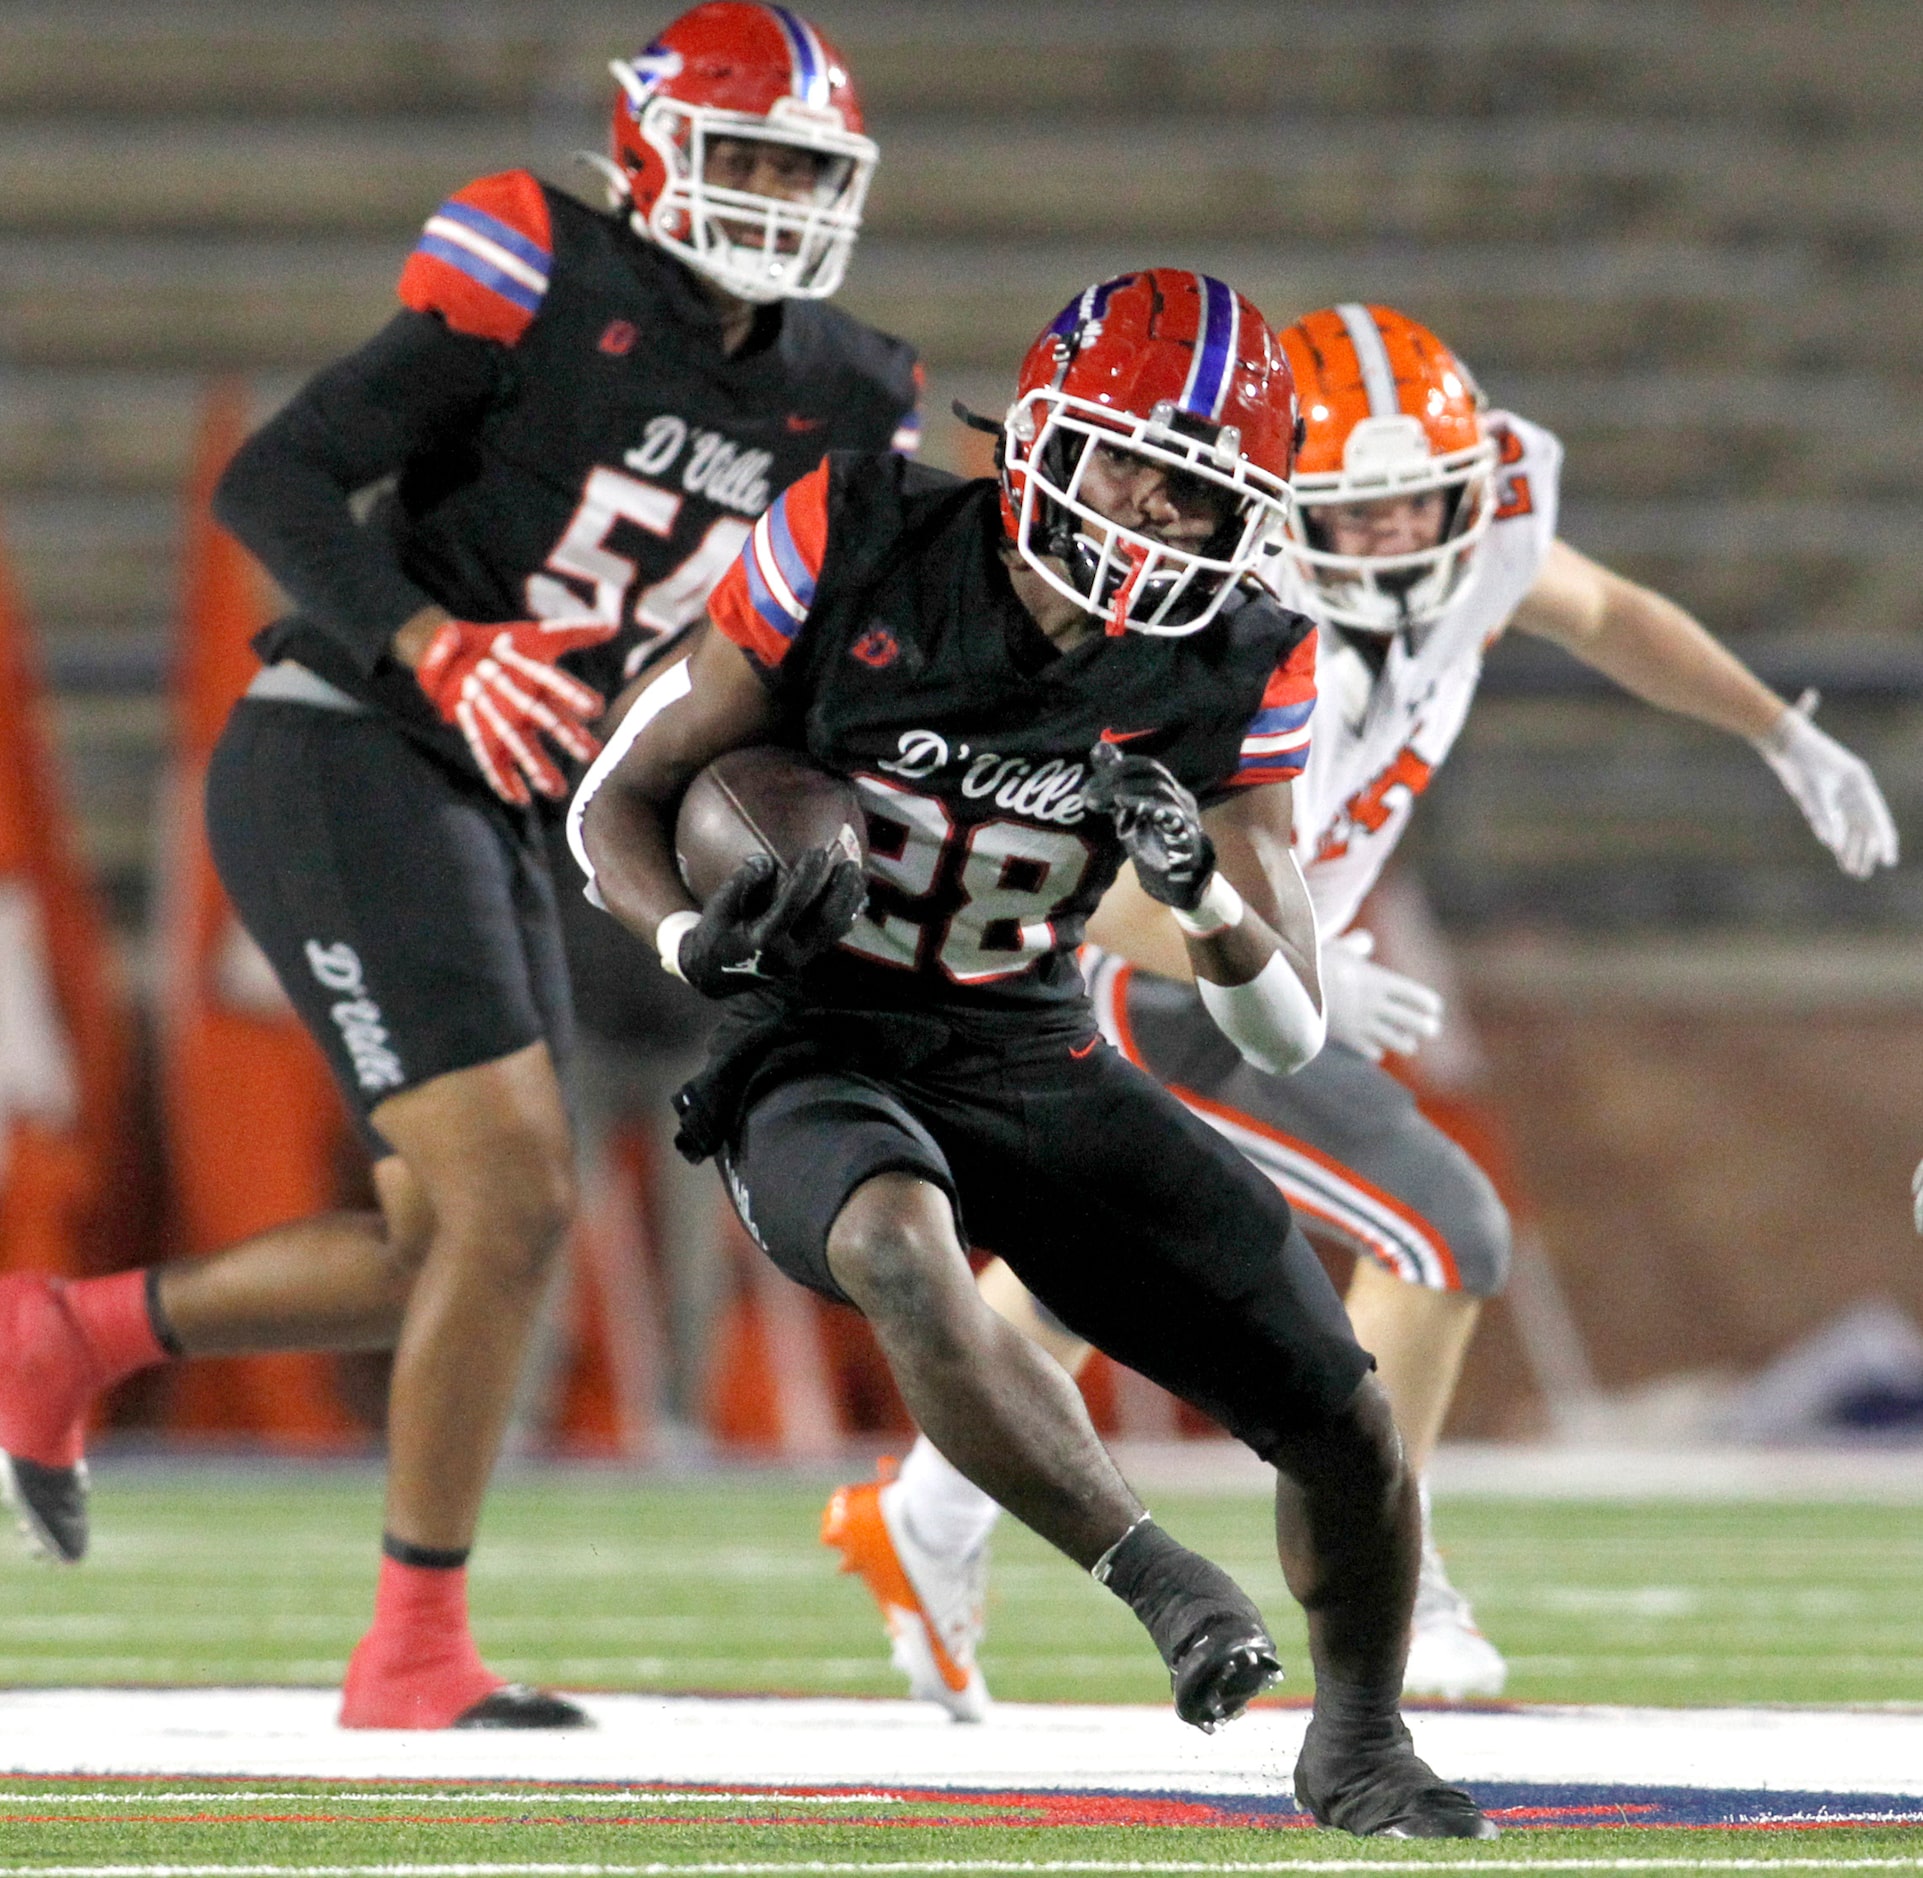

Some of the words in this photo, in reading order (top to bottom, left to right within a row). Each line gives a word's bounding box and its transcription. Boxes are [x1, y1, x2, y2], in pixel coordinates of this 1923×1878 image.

[623, 415, 774, 516] D'Ville
[877, 729, 1087, 825] D'Ville
[838, 770, 1092, 986] 28
